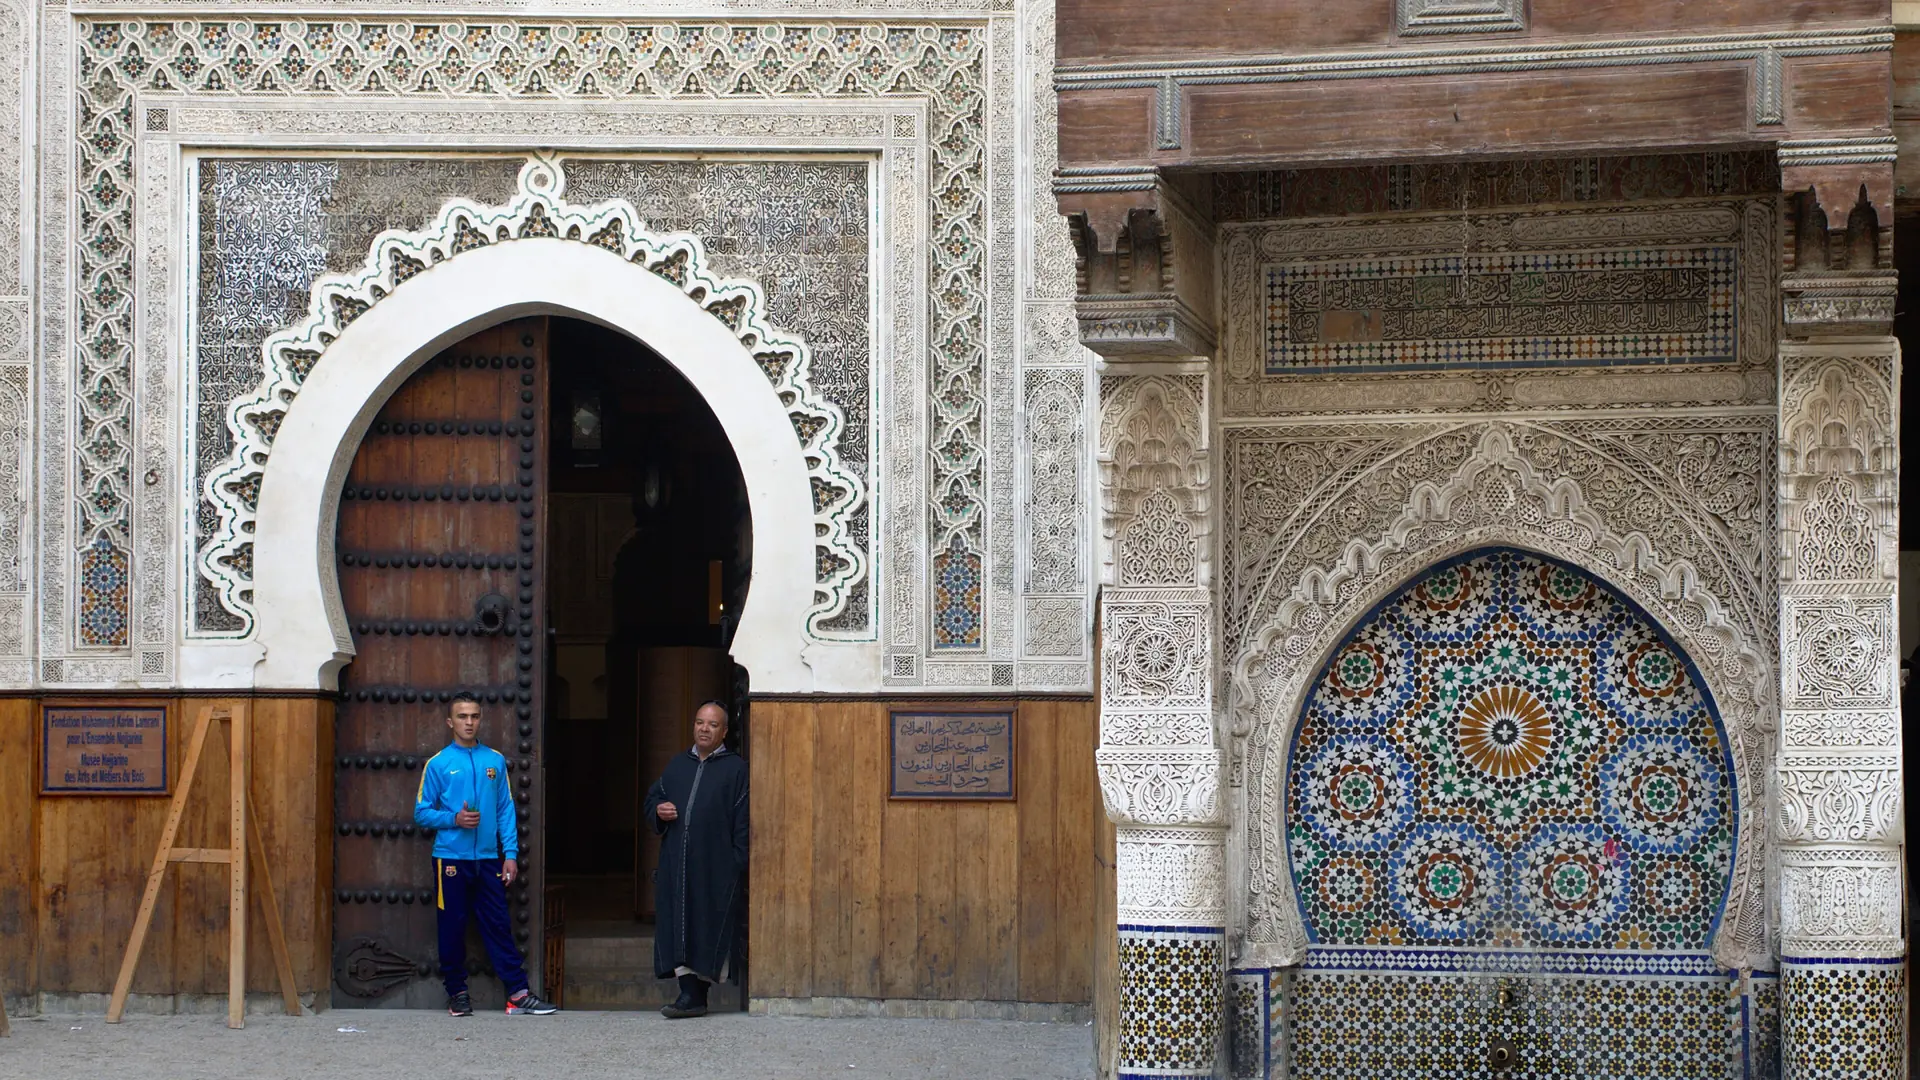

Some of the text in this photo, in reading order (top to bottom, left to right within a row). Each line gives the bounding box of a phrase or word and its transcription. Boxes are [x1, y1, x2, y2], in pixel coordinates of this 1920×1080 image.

[51, 715, 80, 728] Fondation
[117, 715, 134, 728] Karim
[136, 715, 160, 728] Lamrani
[952, 722, 975, 736] محمد
[975, 721, 1005, 736] مؤسسة
[67, 734, 80, 748] pour
[117, 732, 143, 748] Nejjarine
[915, 736, 949, 754] النجارين
[102, 753, 128, 769] Nejjarine
[900, 754, 1005, 773] متحف النجارين لفنون
[64, 770, 76, 783] des
[77, 770, 90, 783] Arts
[91, 771, 98, 783] et
[123, 770, 130, 783] du
[132, 770, 145, 783] Bois
[915, 773, 989, 788] وحرف الخشب
